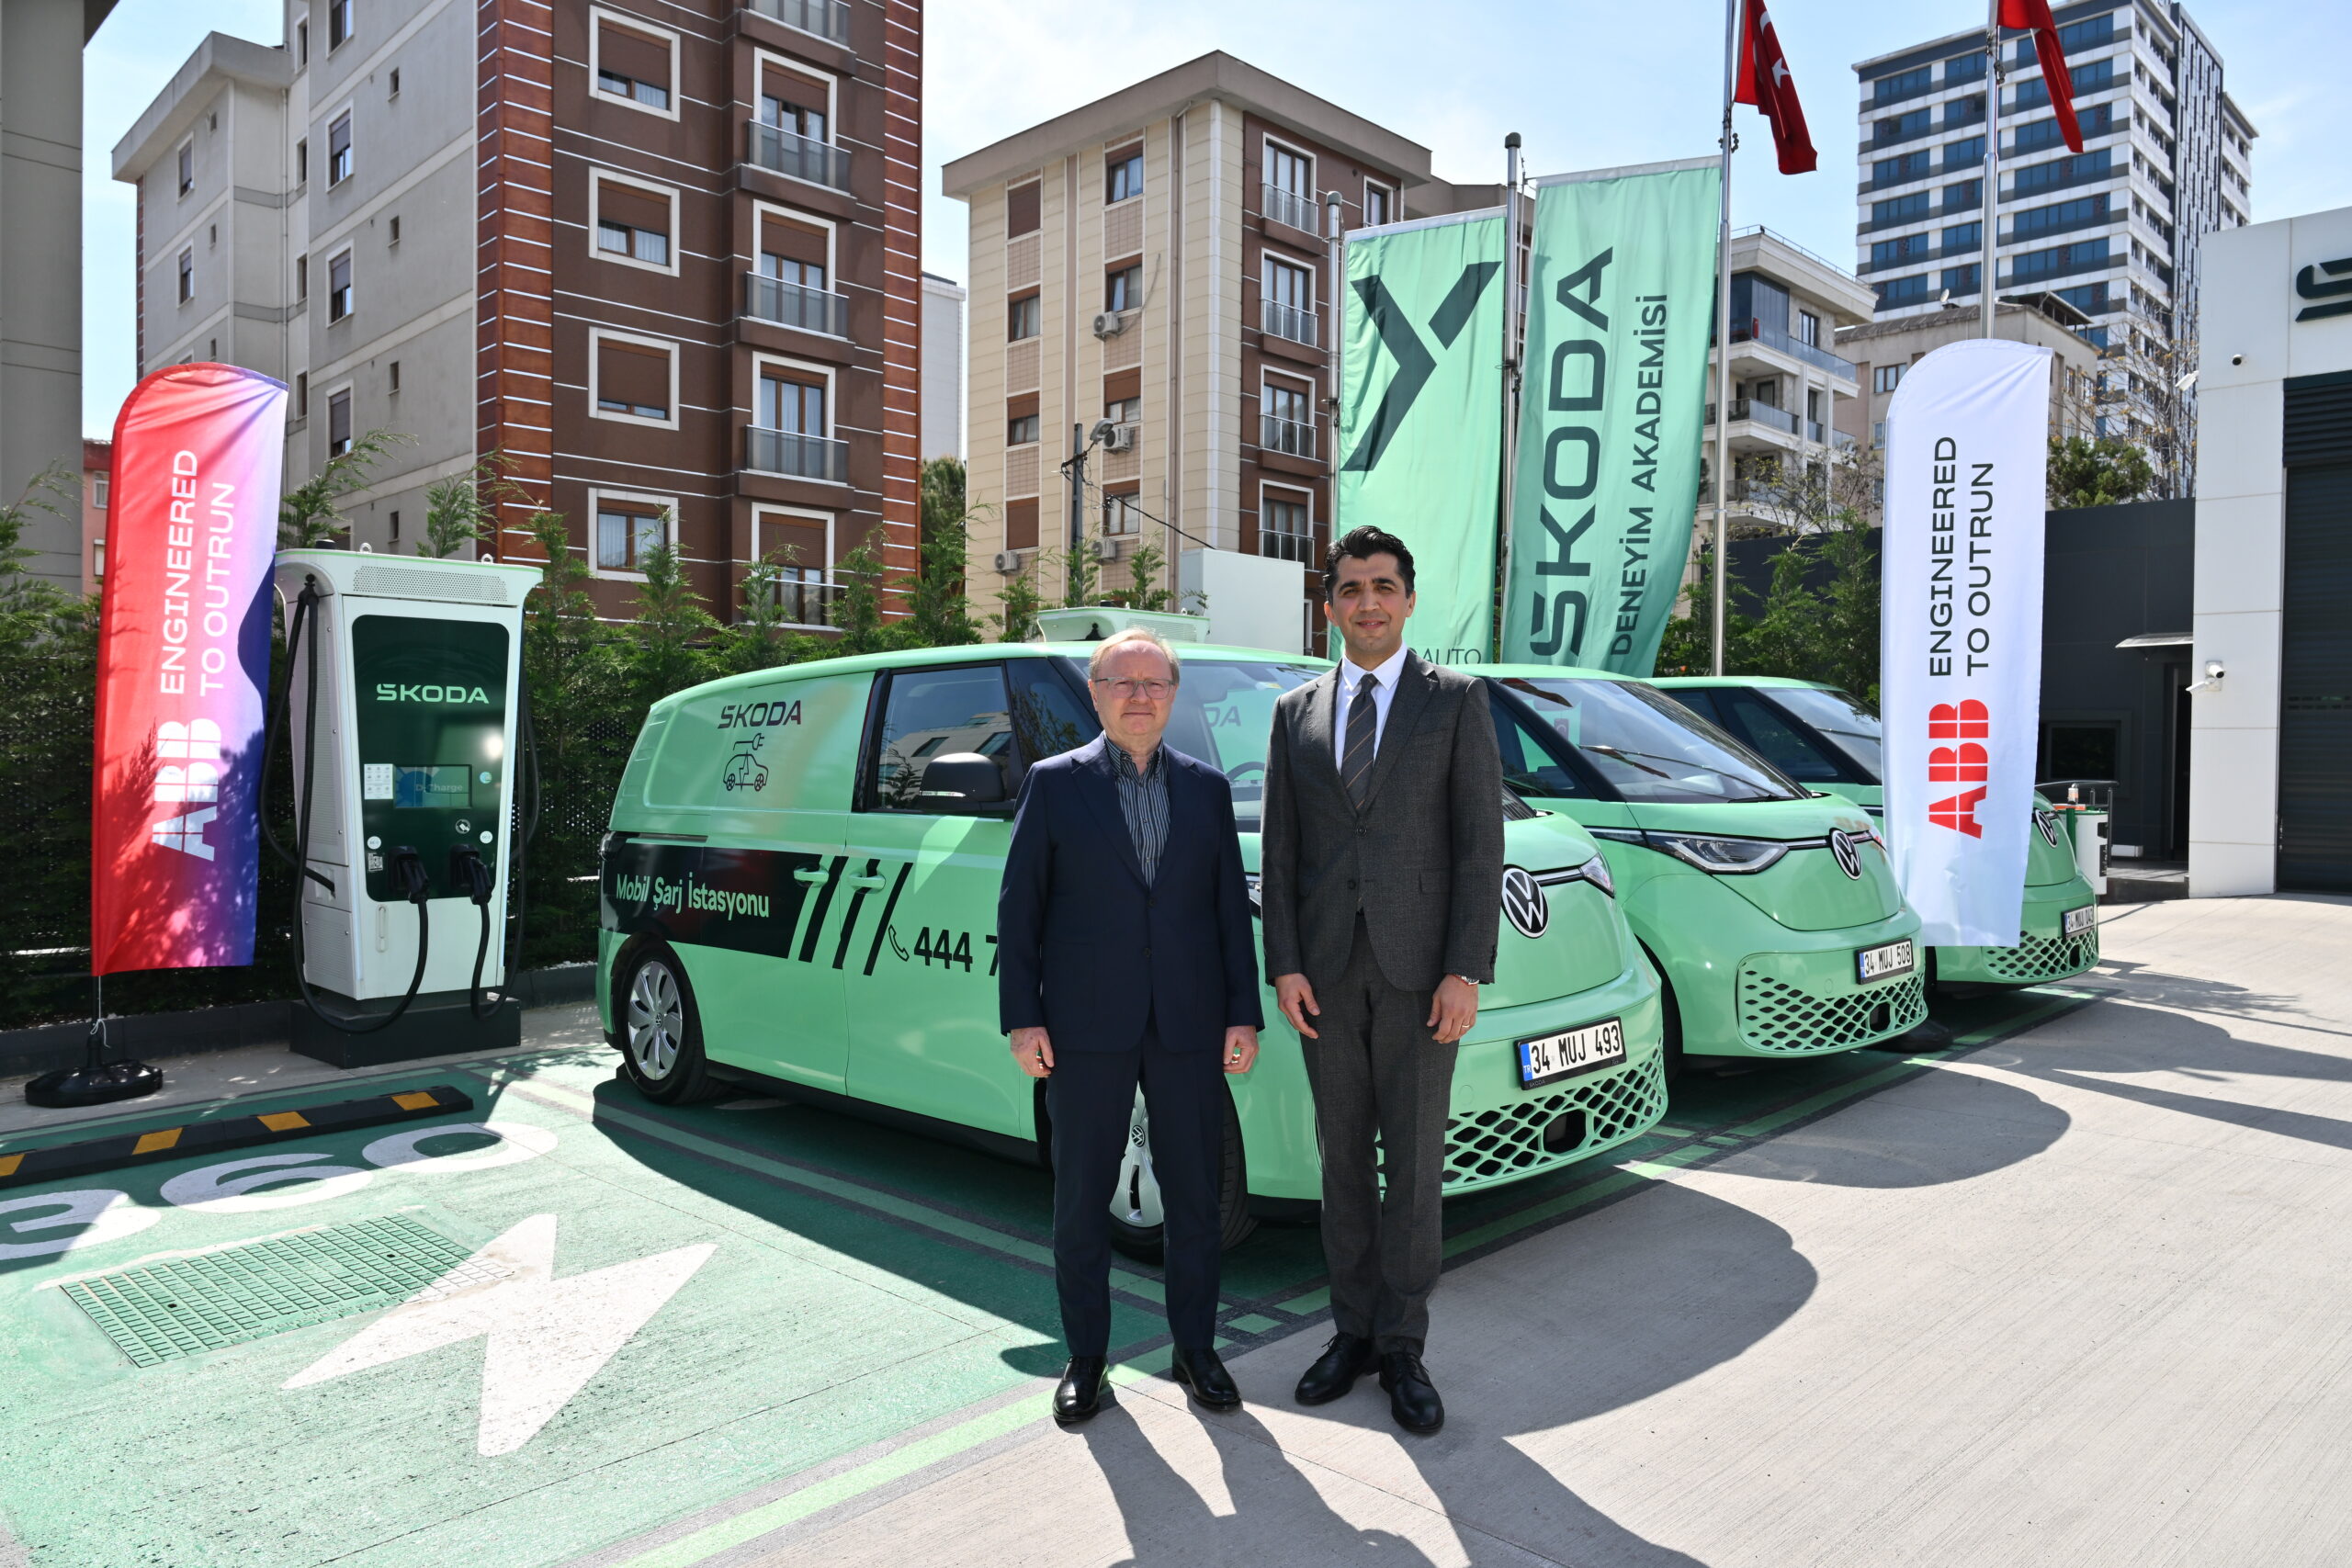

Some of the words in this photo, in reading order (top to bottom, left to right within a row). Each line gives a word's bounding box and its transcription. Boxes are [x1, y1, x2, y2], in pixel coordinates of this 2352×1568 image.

[1631, 294, 1668, 492] AKADEMİSİ
[160, 450, 198, 694] ENGINEERED
[203, 482, 235, 637] OUTRUN
[1611, 507, 1654, 655] DENEYİM
[1929, 436, 1957, 676] ENGINEERED
[1968, 463, 1994, 616] OUTRUN
[199, 648, 225, 696] TO
[1967, 627, 1990, 676] TO
[152, 718, 221, 862] ABB
[1928, 698, 1989, 840] ABB
[616, 874, 650, 902] Mobil
[653, 877, 684, 914] Şarj
[688, 872, 770, 920] İstasyonu
[913, 927, 973, 973] 444
[1865, 953, 1874, 975] 34
[1879, 948, 1893, 971] MUJ
[1896, 943, 1911, 965] 508
[1531, 1043, 1550, 1074] 34
[1558, 1032, 1586, 1066] MUJ
[1595, 1024, 1620, 1056] 493
